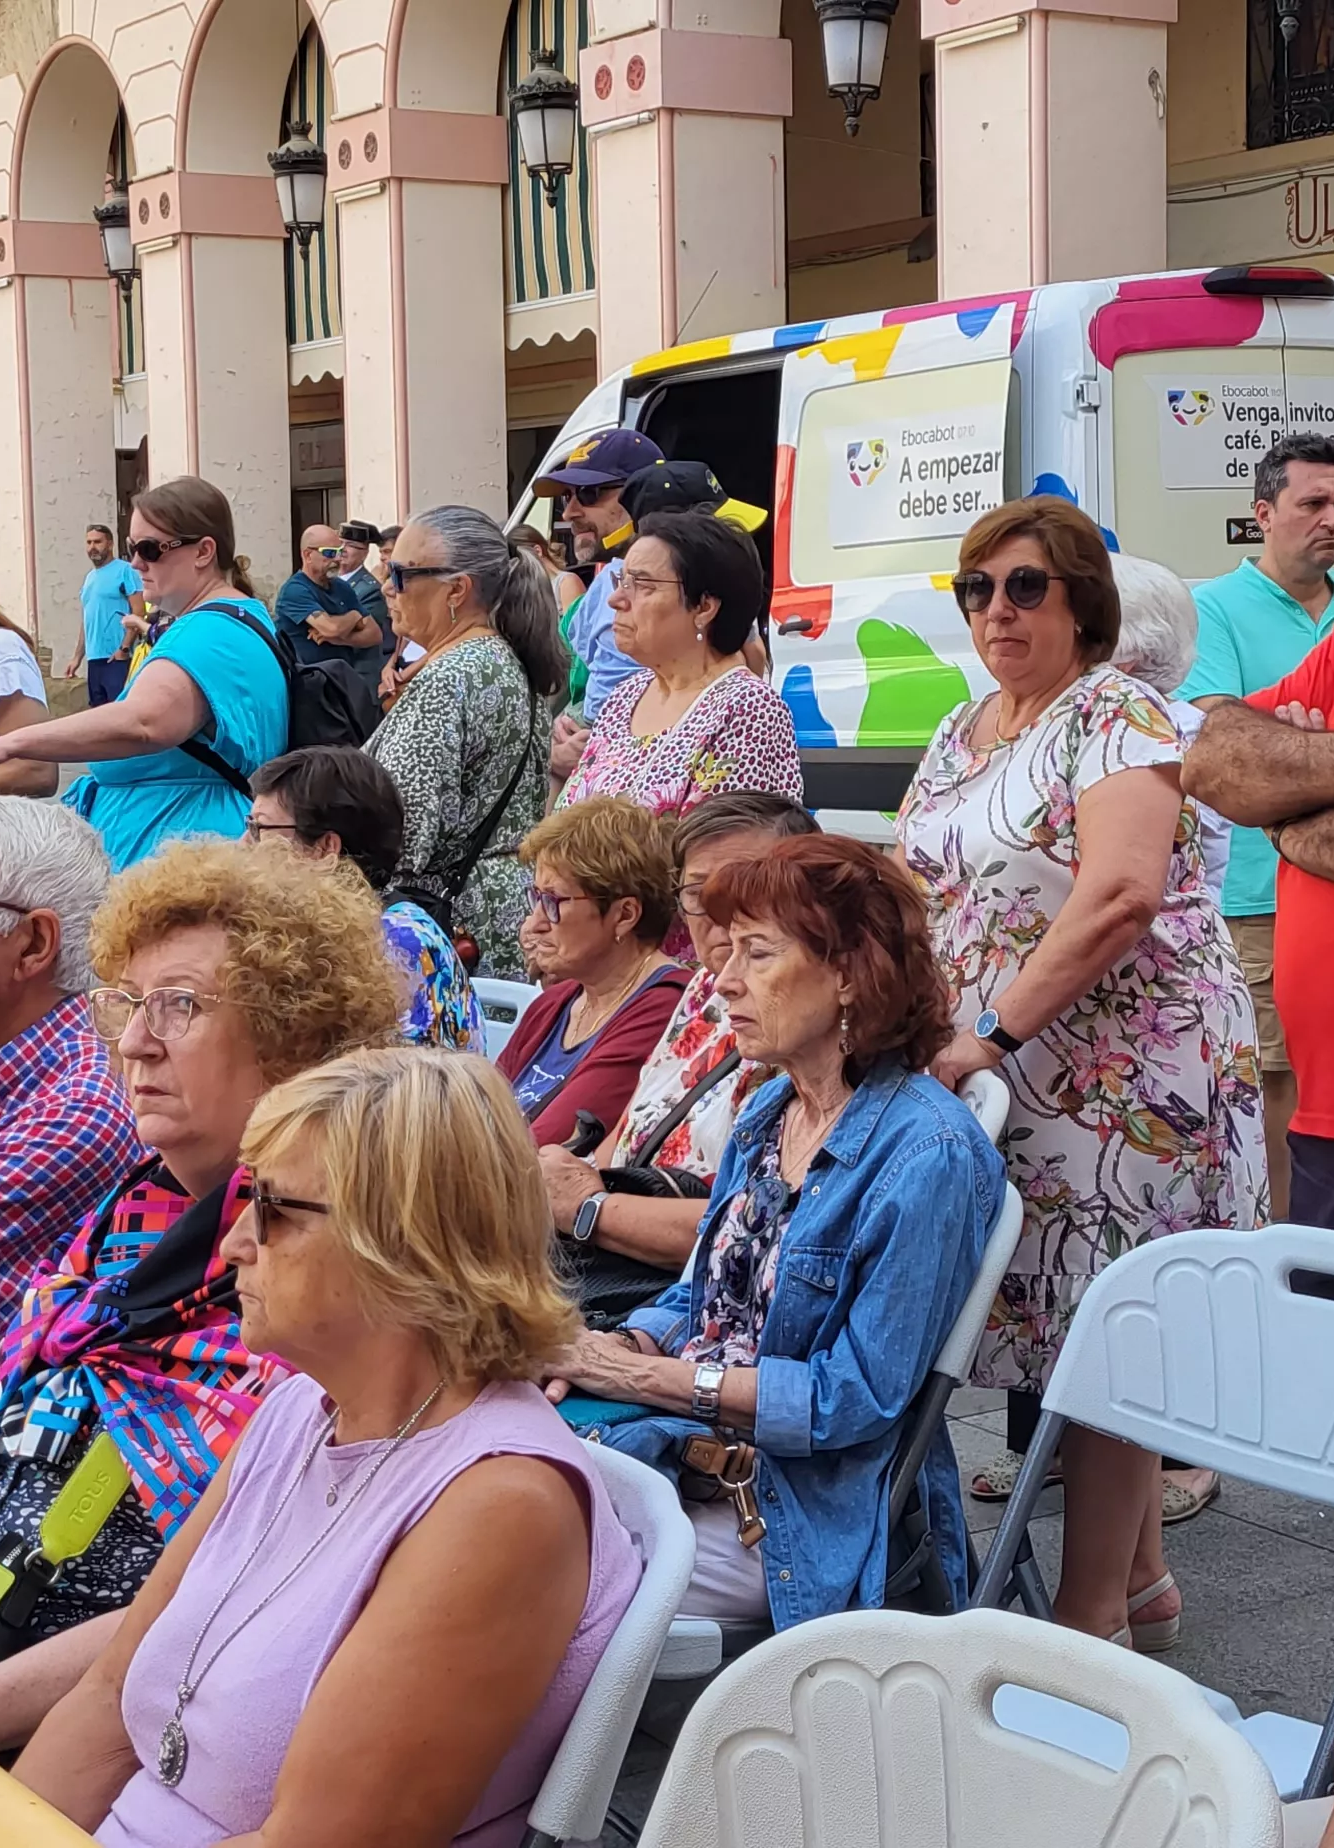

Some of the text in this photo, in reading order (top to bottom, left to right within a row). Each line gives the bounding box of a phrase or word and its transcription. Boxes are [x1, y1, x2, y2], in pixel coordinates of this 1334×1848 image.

[1222, 384, 1269, 397] Ebocabot
[1222, 402, 1284, 426] Venga,
[901, 425, 955, 447] Ebocabot
[1224, 430, 1266, 450] café.
[899, 450, 1002, 484] A empezar
[1226, 458, 1249, 478] de
[899, 490, 998, 519] debe ser...
[69, 1470, 111, 1524] TOUS
